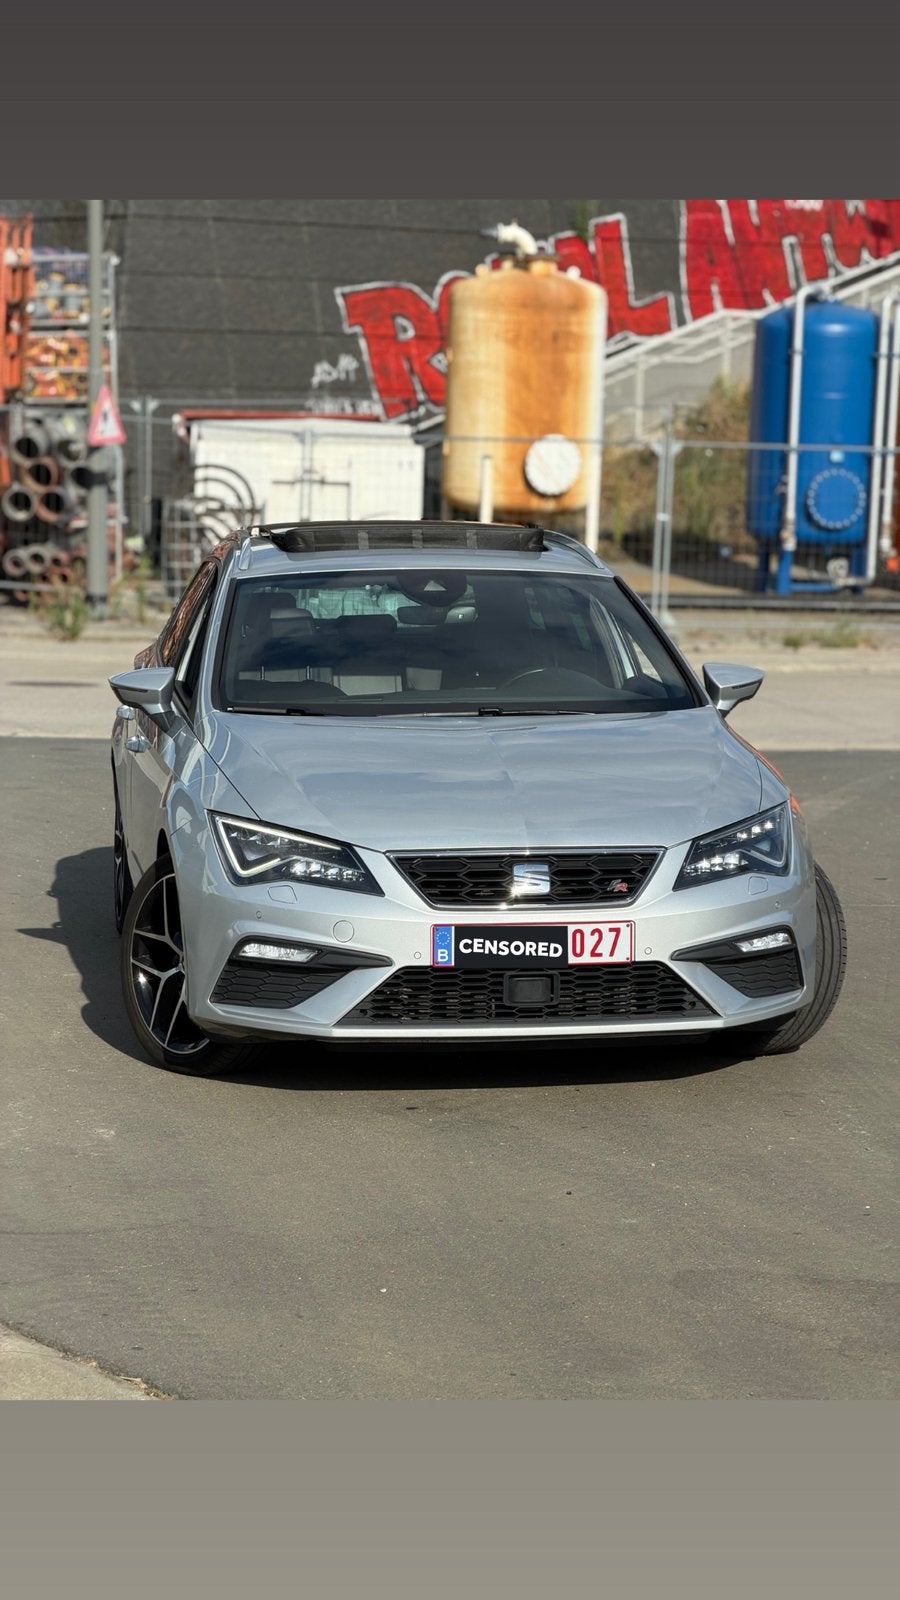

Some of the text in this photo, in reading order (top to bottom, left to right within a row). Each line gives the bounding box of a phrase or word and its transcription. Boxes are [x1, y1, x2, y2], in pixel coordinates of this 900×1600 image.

[607, 879, 628, 892] FR
[571, 927, 621, 958] 027
[437, 949, 449, 962] B
